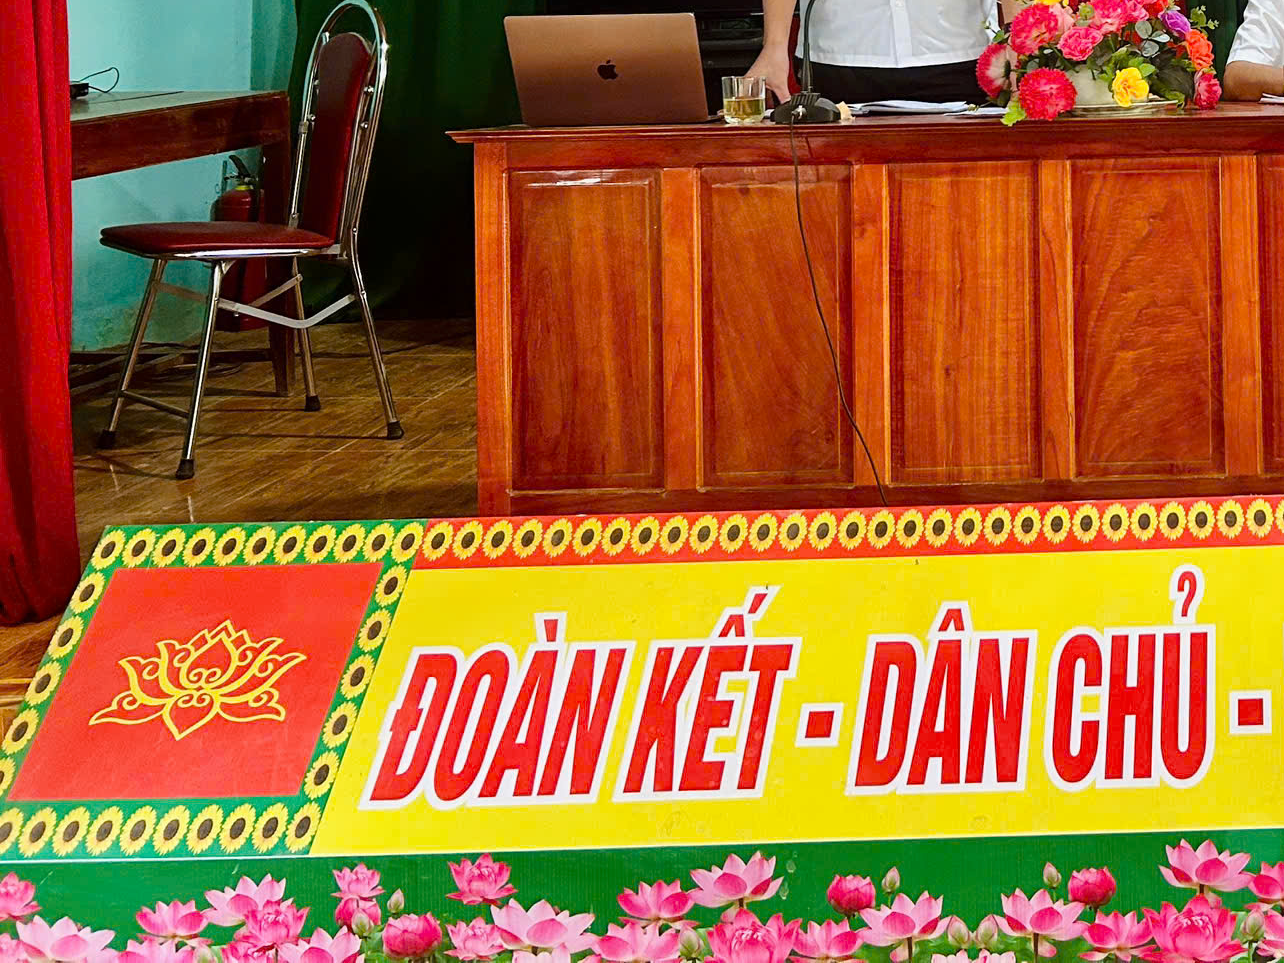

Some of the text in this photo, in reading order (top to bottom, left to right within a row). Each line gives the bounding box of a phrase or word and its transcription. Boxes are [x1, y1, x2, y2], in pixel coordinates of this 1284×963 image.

[367, 616, 625, 803] ĐOÀN
[618, 590, 797, 795] KẾT
[852, 605, 1032, 789] DÂN
[1049, 569, 1213, 783] CHỦ
